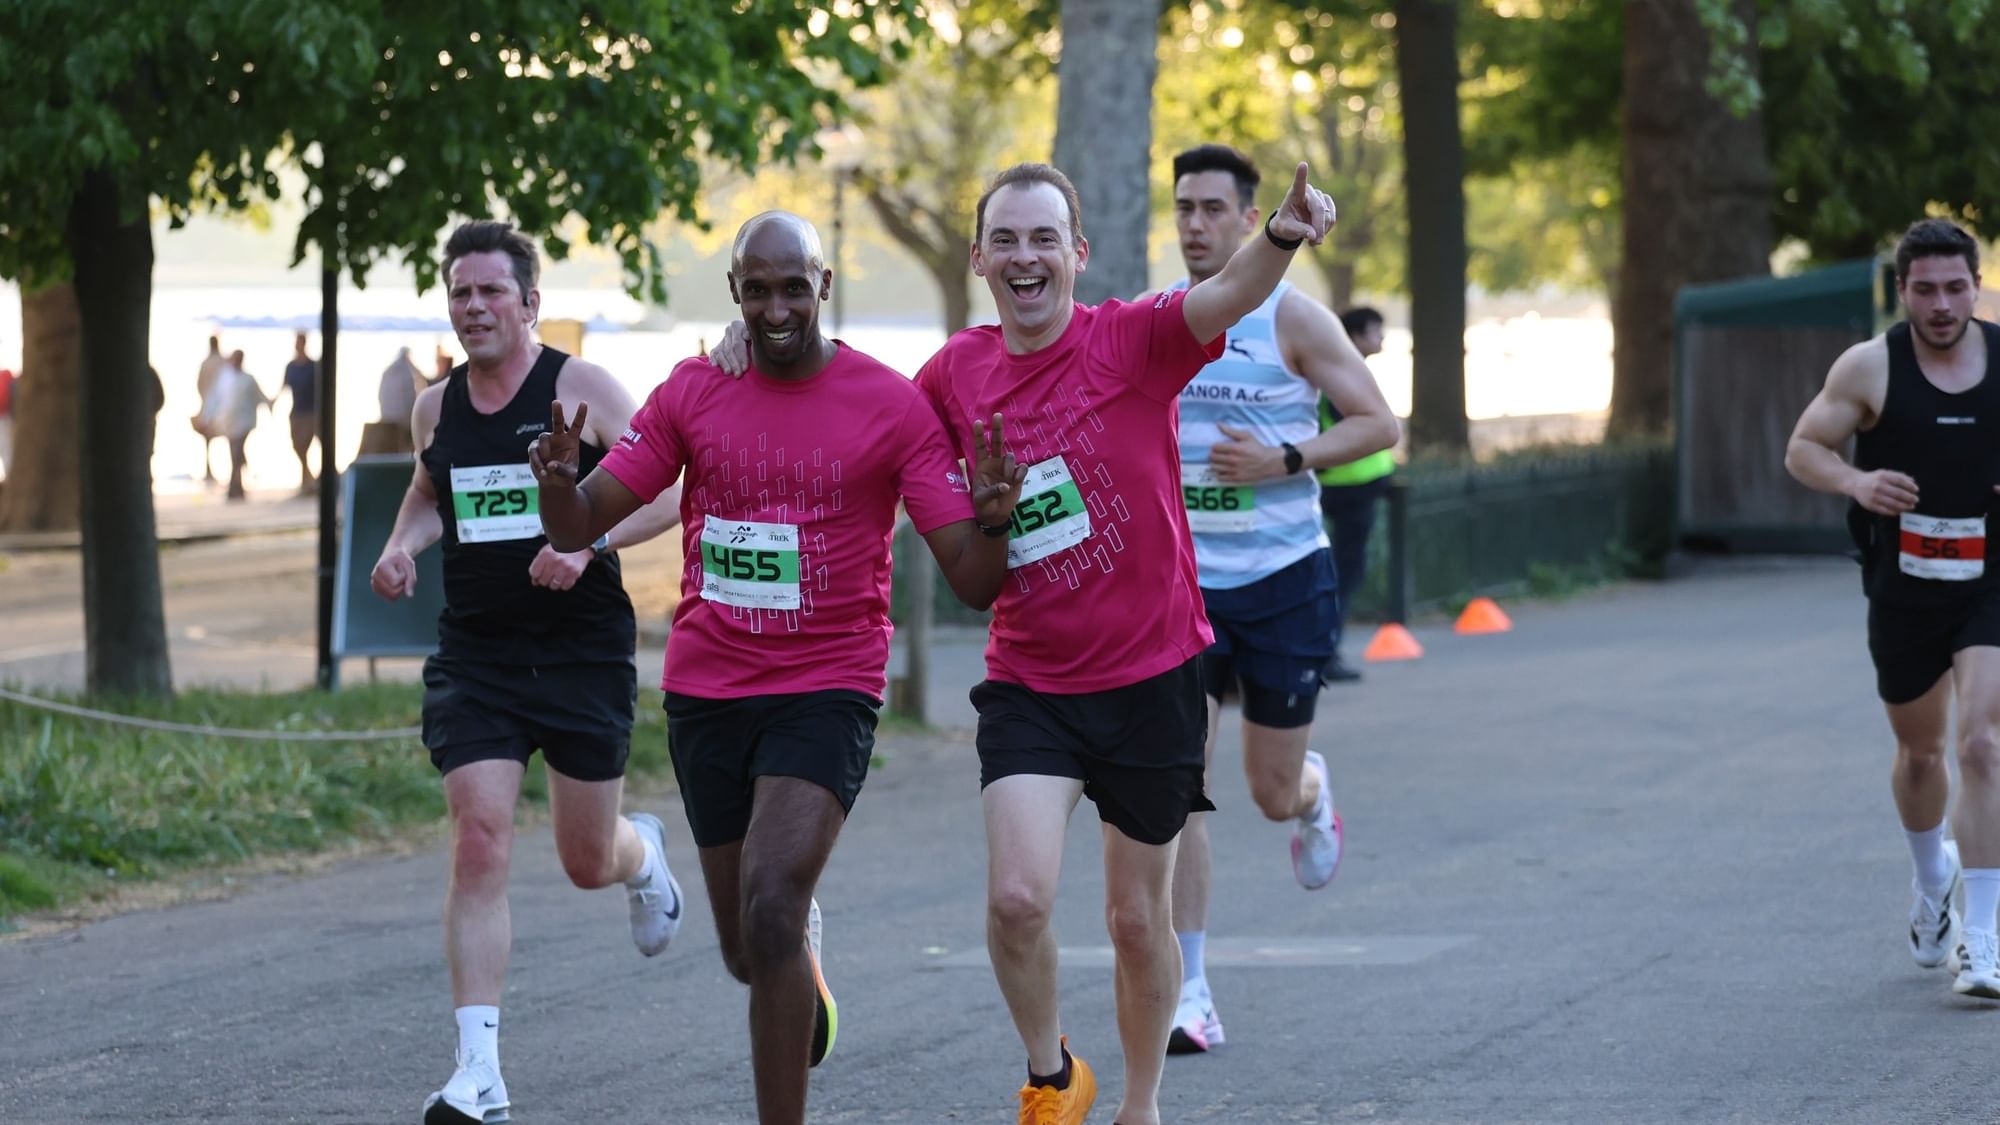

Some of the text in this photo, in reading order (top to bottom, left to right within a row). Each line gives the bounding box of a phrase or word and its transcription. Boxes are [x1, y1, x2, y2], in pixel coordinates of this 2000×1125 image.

[1181, 385, 1231, 400] ANOR
[467, 489, 527, 517] 729
[1182, 486, 1239, 511] 566
[770, 534, 789, 542] TREK
[1921, 538, 1959, 559] 56
[711, 545, 781, 581] 455
